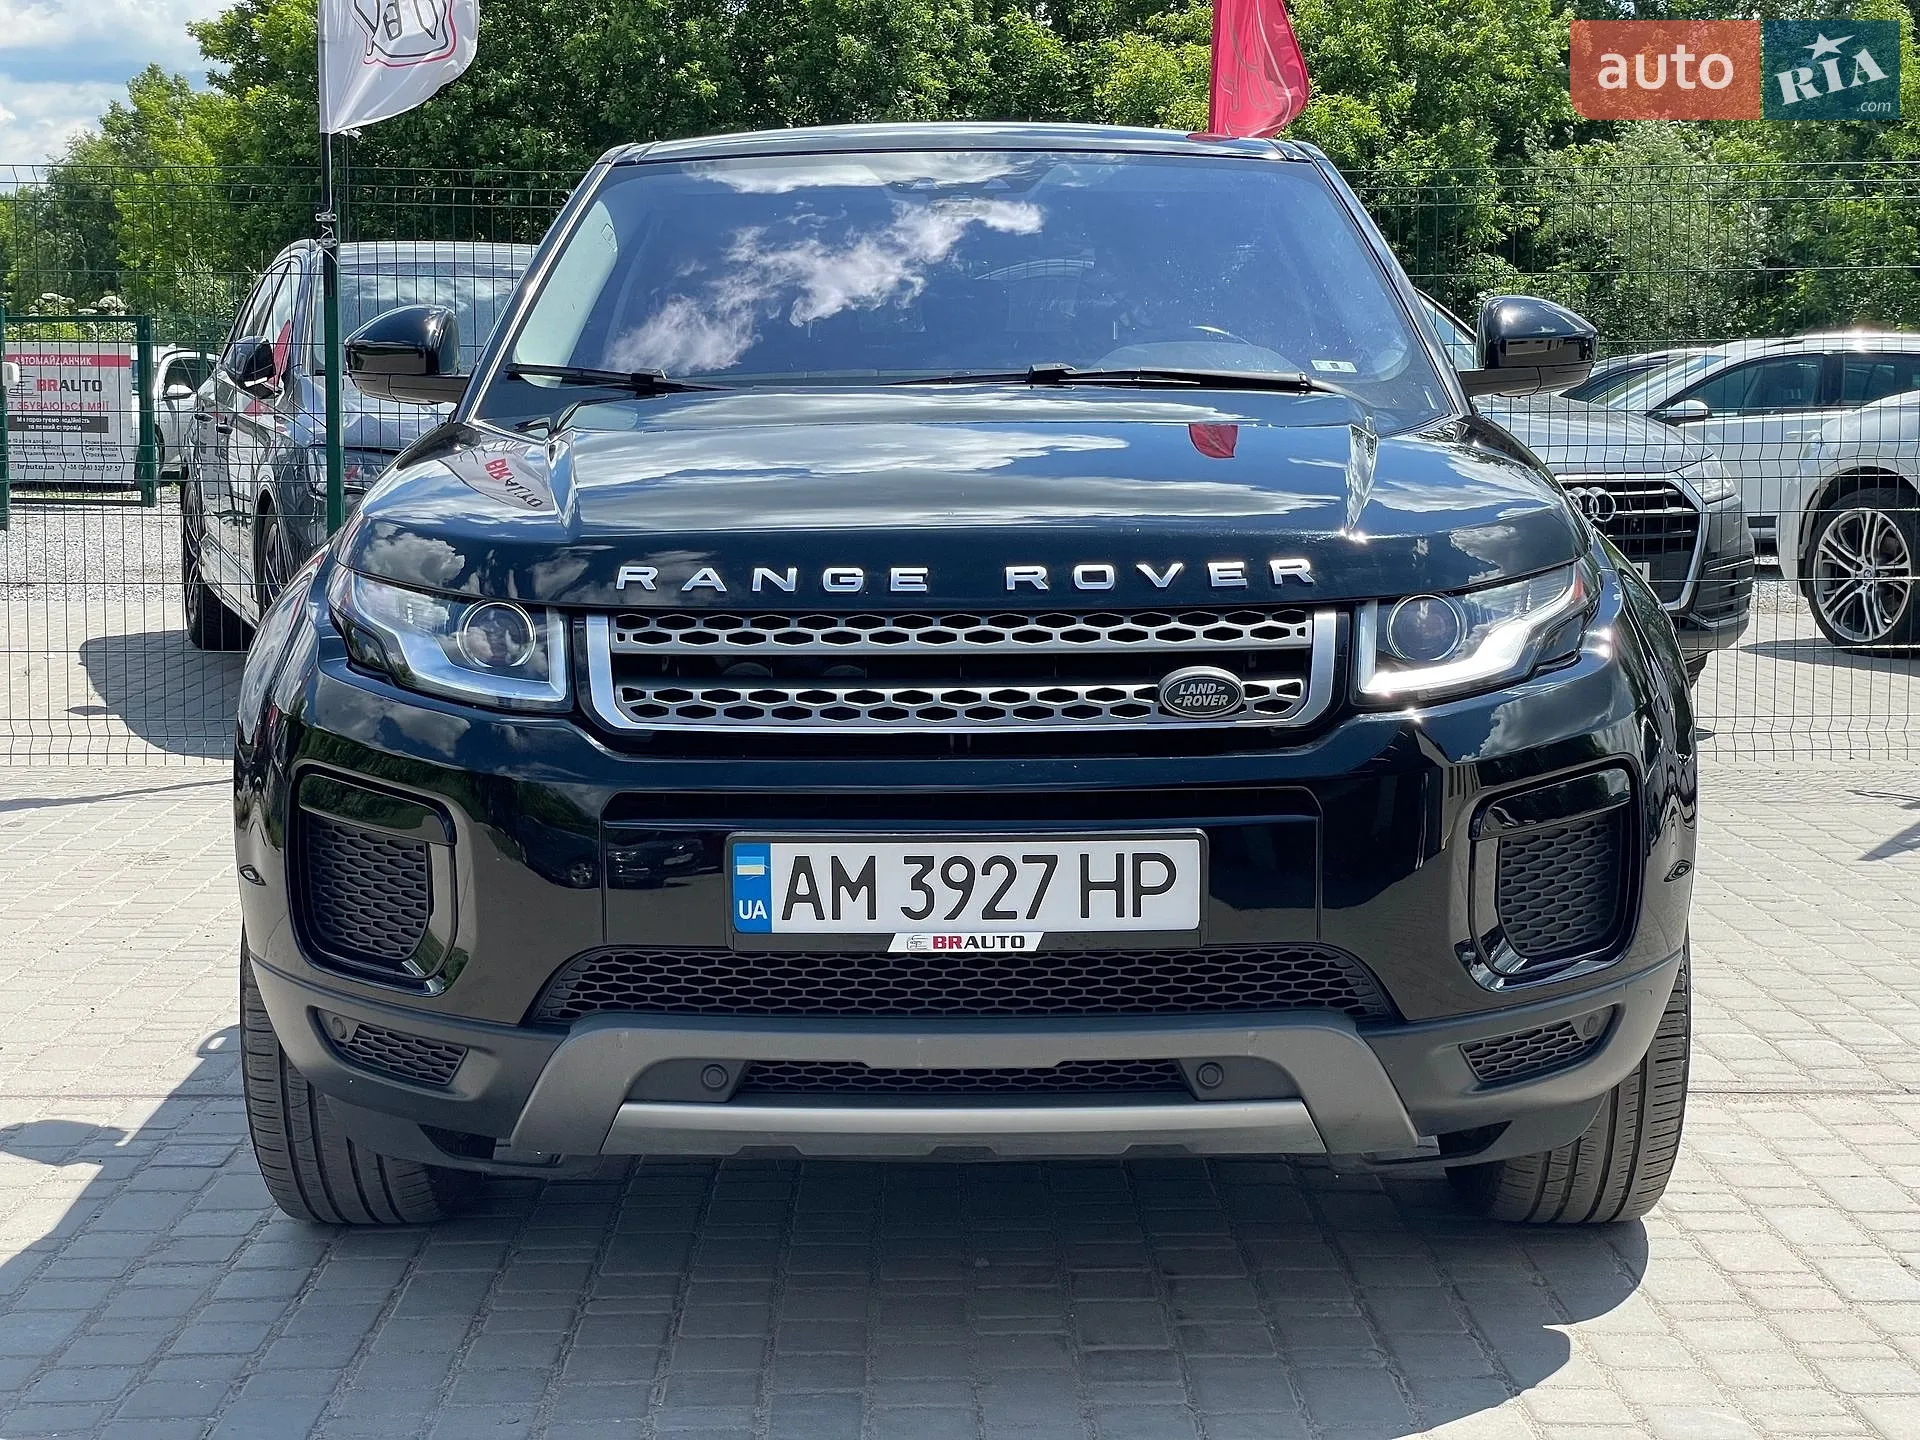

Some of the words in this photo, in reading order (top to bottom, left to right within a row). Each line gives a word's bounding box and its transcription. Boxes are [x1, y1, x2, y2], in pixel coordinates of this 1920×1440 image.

[36, 379, 102, 392] BRAUTO
[615, 566, 930, 594] RANGE
[1005, 558, 1315, 592] ROVER
[781, 855, 877, 921] AM
[899, 854, 1059, 921] 3927
[1079, 852, 1178, 919] HP
[738, 900, 768, 920] UA
[932, 935, 1025, 950] BRAUTO
